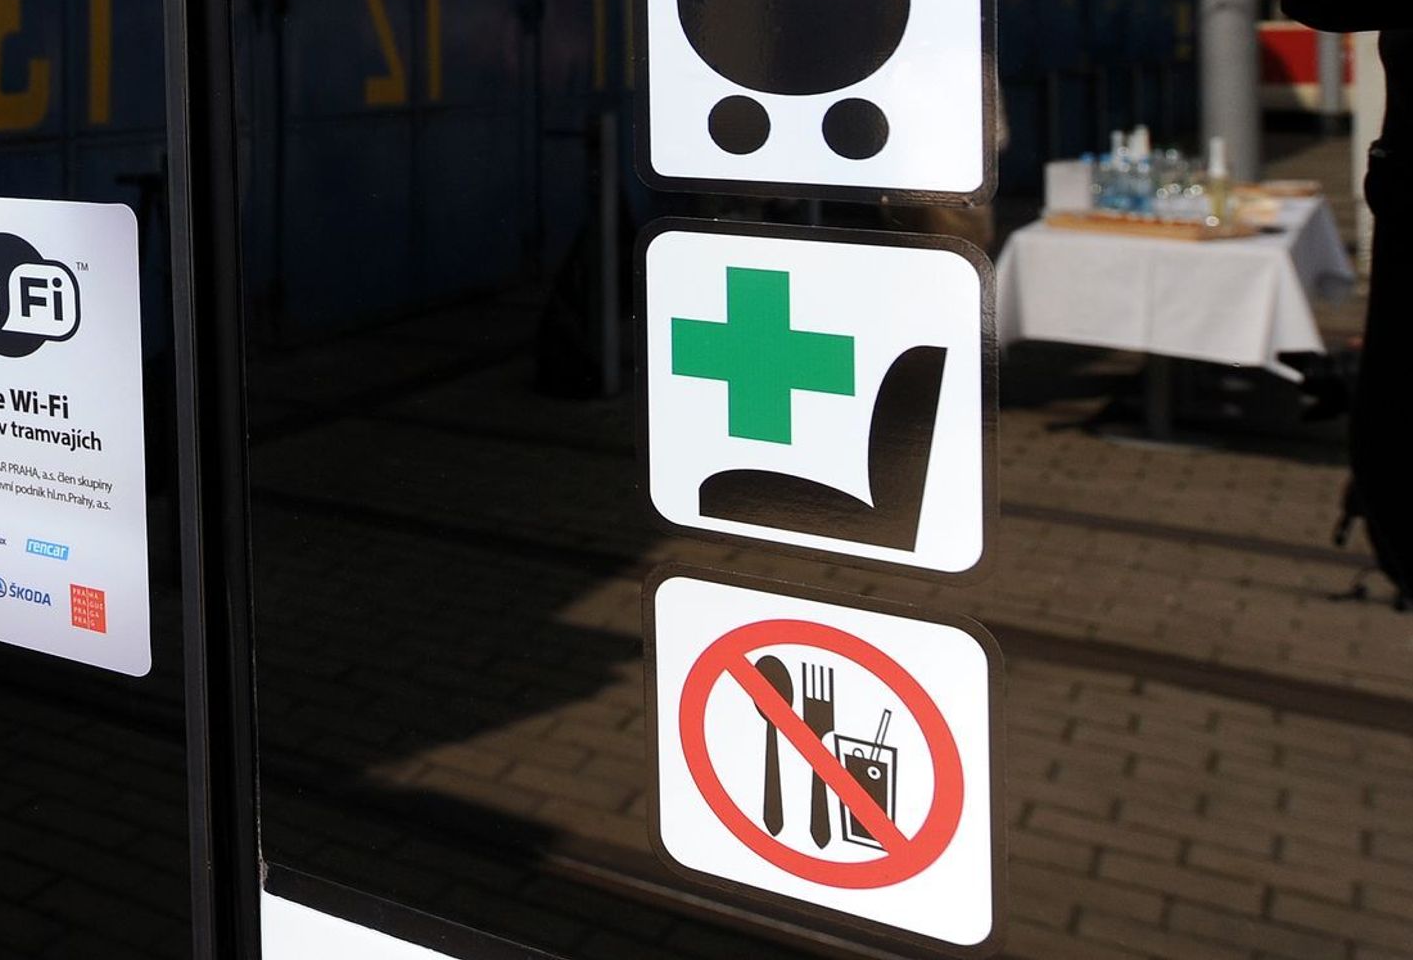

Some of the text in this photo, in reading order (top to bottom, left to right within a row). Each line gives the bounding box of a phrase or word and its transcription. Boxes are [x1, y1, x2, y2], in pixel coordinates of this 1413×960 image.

[10, 388, 70, 419] Wi-Fi
[11, 422, 101, 451] tramvajích
[8, 463, 40, 479] PRAHA,
[42, 472, 56, 481] a.s.
[57, 472, 76, 484] člen
[78, 476, 112, 494] skupiny
[15, 485, 46, 498] podnik
[96, 500, 111, 510] a.s.
[27, 539, 66, 559] rencar
[9, 583, 51, 606] ŠKODA
